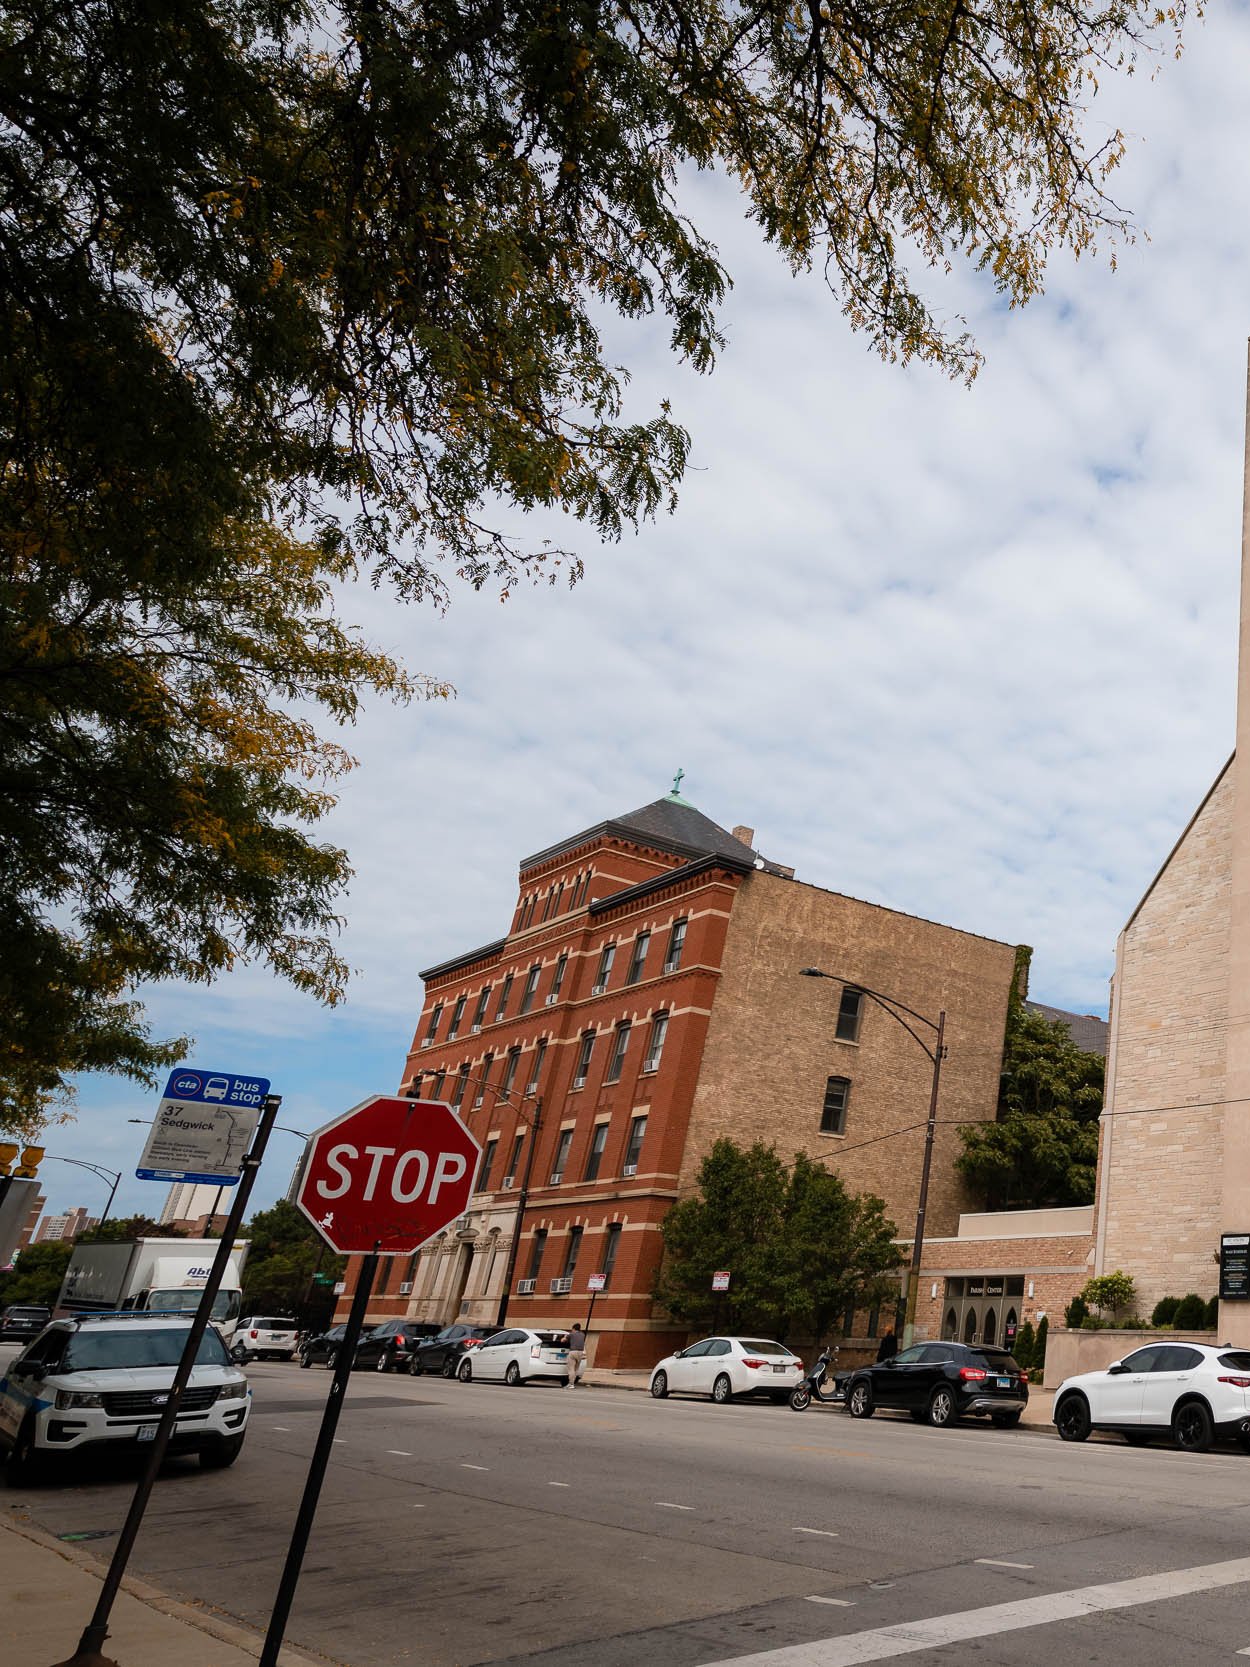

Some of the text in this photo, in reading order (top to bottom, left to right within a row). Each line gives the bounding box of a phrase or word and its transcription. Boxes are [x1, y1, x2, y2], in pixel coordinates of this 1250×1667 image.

[178, 1081, 197, 1089] cta
[234, 1080, 260, 1092] bus
[230, 1092, 261, 1104] stop
[164, 1105, 184, 1116] 37
[161, 1118, 215, 1131] Sedgwick
[316, 1143, 467, 1205] STOP
